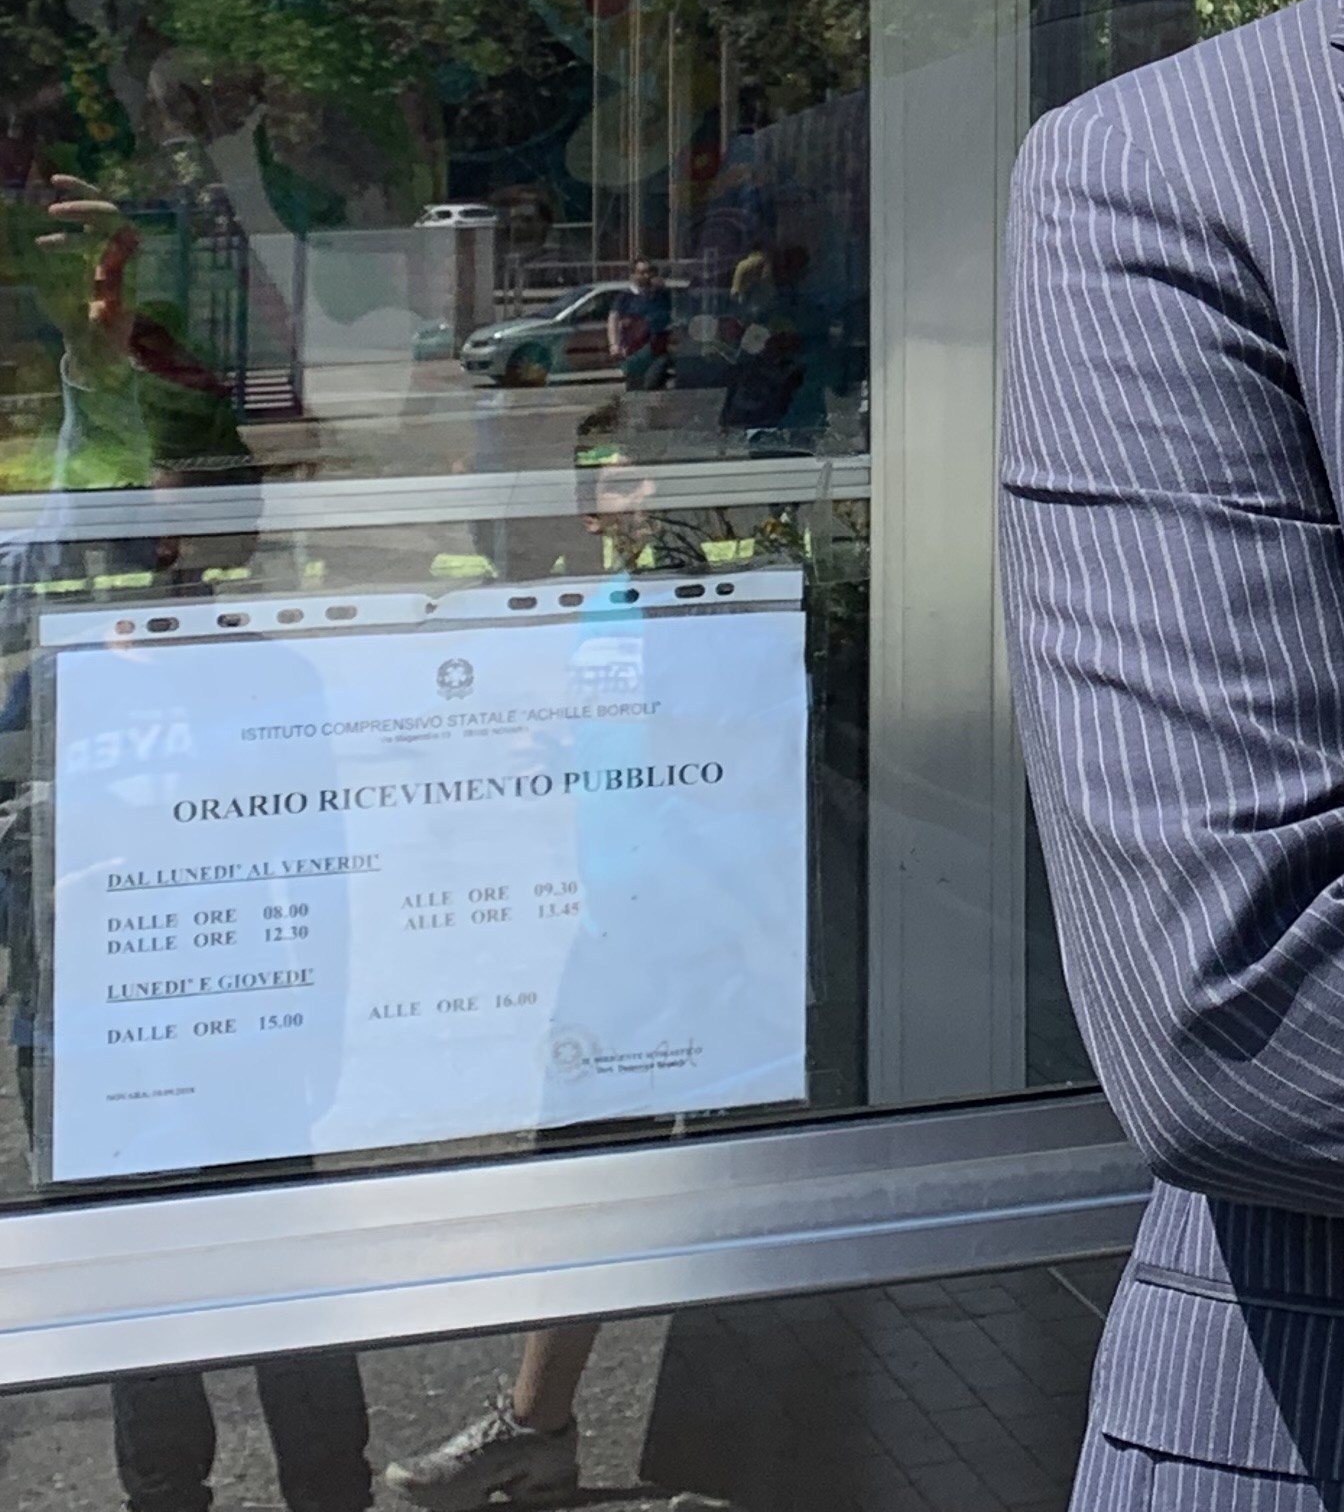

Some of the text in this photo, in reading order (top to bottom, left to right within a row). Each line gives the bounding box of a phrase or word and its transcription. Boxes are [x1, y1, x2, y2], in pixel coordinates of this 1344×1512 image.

[241, 724, 317, 741] ISTITUTO
[321, 715, 442, 736] COMPRENSIVO
[447, 709, 516, 728] STATALE
[173, 761, 723, 823] ORARIO RICEVIMENTO PUBBLICO
[107, 871, 150, 889] DAL
[247, 862, 275, 879] AL
[107, 935, 178, 955] DALLE
[193, 930, 237, 947] ORE
[264, 925, 309, 943] 12.30
[404, 912, 456, 931] ALLE
[471, 908, 512, 924] ORE
[108, 913, 178, 933] DALLE
[194, 908, 237, 926] ORE
[263, 903, 309, 920] 08.00
[401, 891, 453, 909] ALLE
[468, 886, 510, 903] ORE
[200, 976, 212, 991] E
[107, 1025, 177, 1045] DALLE
[193, 1018, 237, 1037] ORE
[259, 1013, 304, 1031] 15.00
[368, 1002, 421, 1020] ALLE
[437, 997, 479, 1014] ORE
